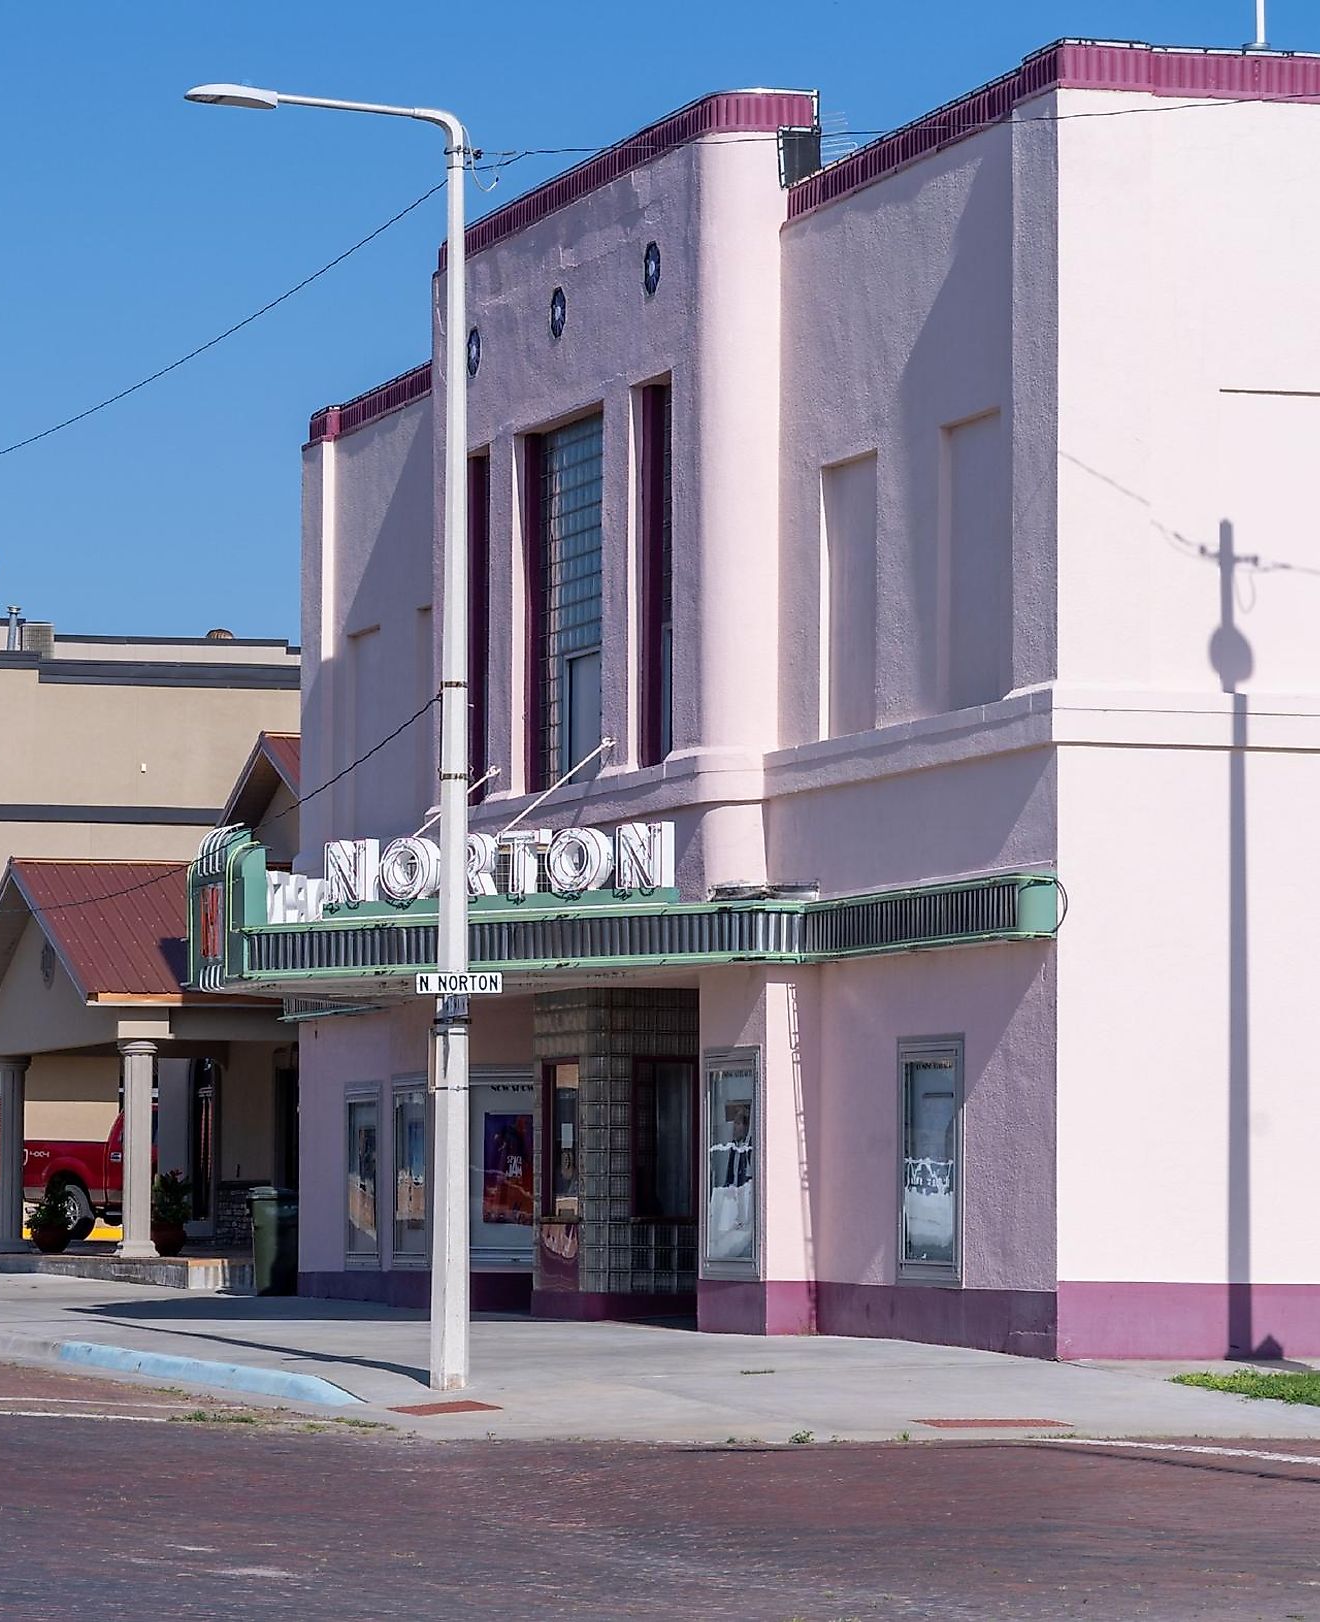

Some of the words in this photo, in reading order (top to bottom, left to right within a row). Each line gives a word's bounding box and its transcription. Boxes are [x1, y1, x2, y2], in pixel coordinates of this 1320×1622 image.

[324, 821, 675, 902] NORTON
[419, 975, 433, 992] N.
[438, 975, 498, 992] NORTON
